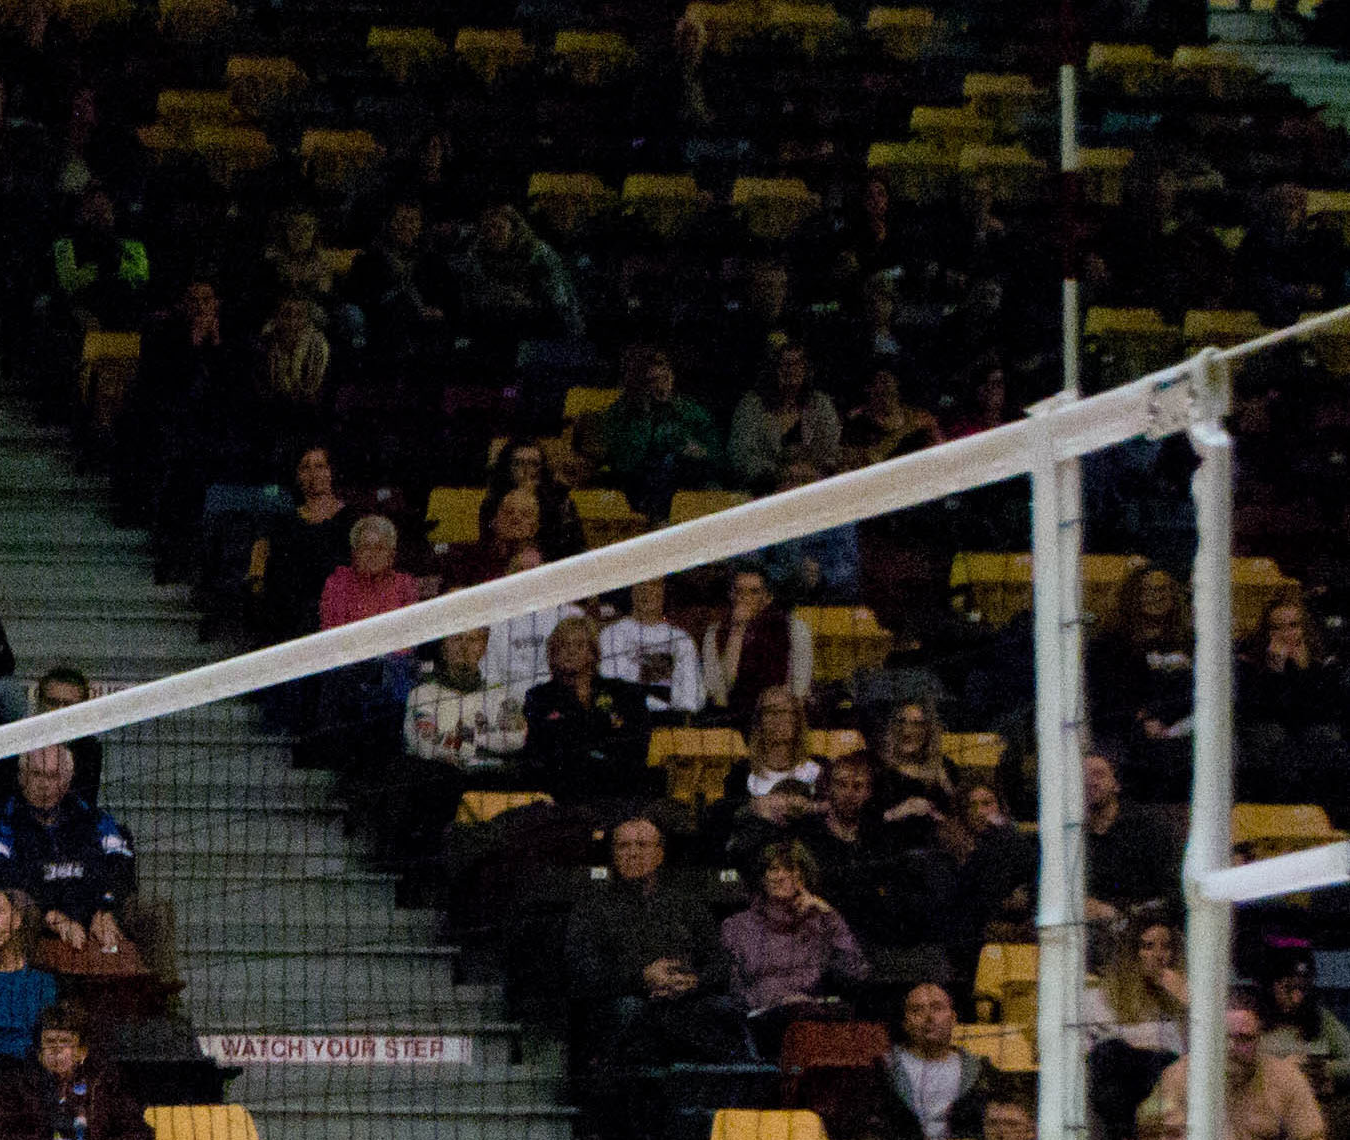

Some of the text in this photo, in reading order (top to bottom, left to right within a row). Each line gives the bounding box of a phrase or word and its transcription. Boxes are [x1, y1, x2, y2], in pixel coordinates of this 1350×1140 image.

[221, 1038, 444, 1058] WATCH YOUR STEP
